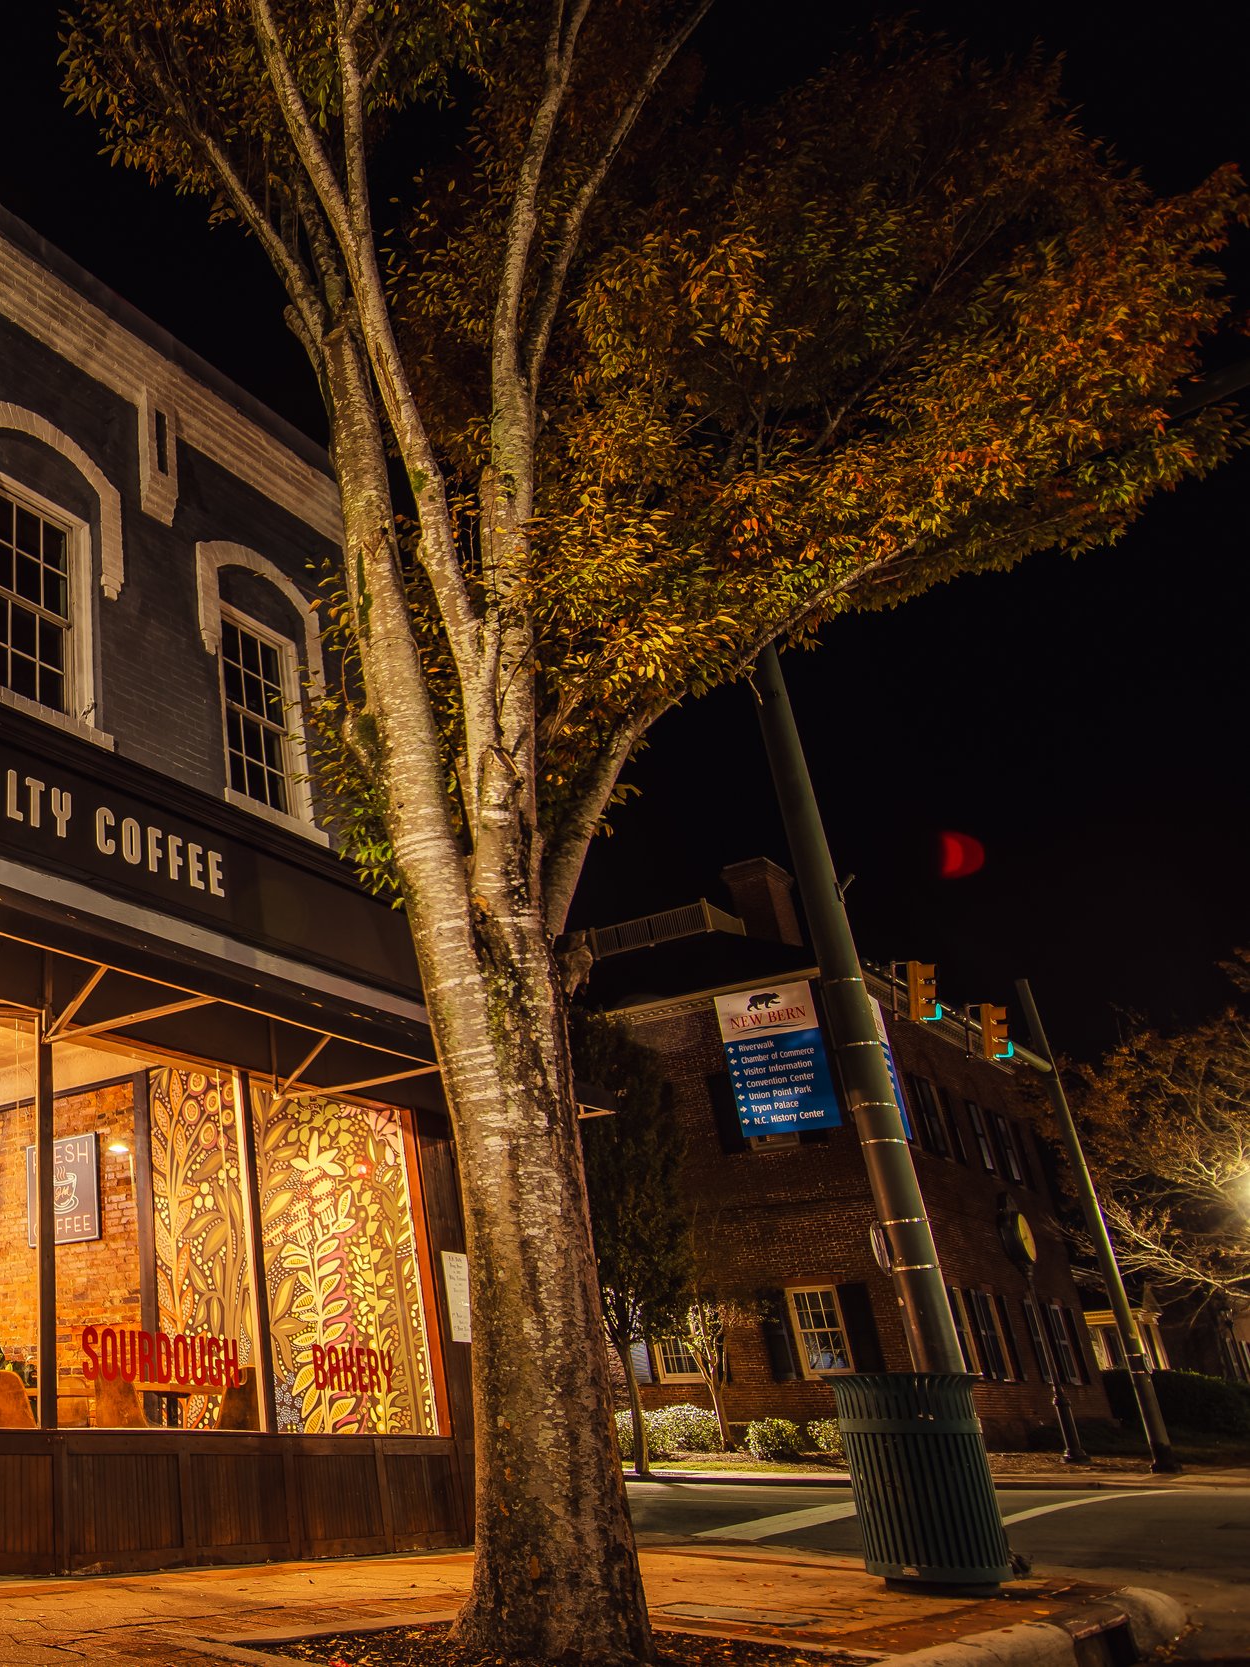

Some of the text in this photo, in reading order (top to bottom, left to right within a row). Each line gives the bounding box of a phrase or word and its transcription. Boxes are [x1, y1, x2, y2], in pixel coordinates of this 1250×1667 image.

[95, 806, 225, 898] COFFEE
[730, 1006, 807, 1029] NEW BERN
[738, 1040, 775, 1052] Riverwalk
[741, 1047, 815, 1064] Chamber of Commerce
[743, 1060, 813, 1076] Visitor Information
[746, 1072, 815, 1088] Convention Center
[749, 1085, 812, 1100] Union Point Park
[751, 1100, 799, 1113] Tryon Palace
[754, 1109, 825, 1125] N.C. History Center
[82, 1326, 240, 1388] SOURDOUGH
[312, 1343, 393, 1393] BAKERY
